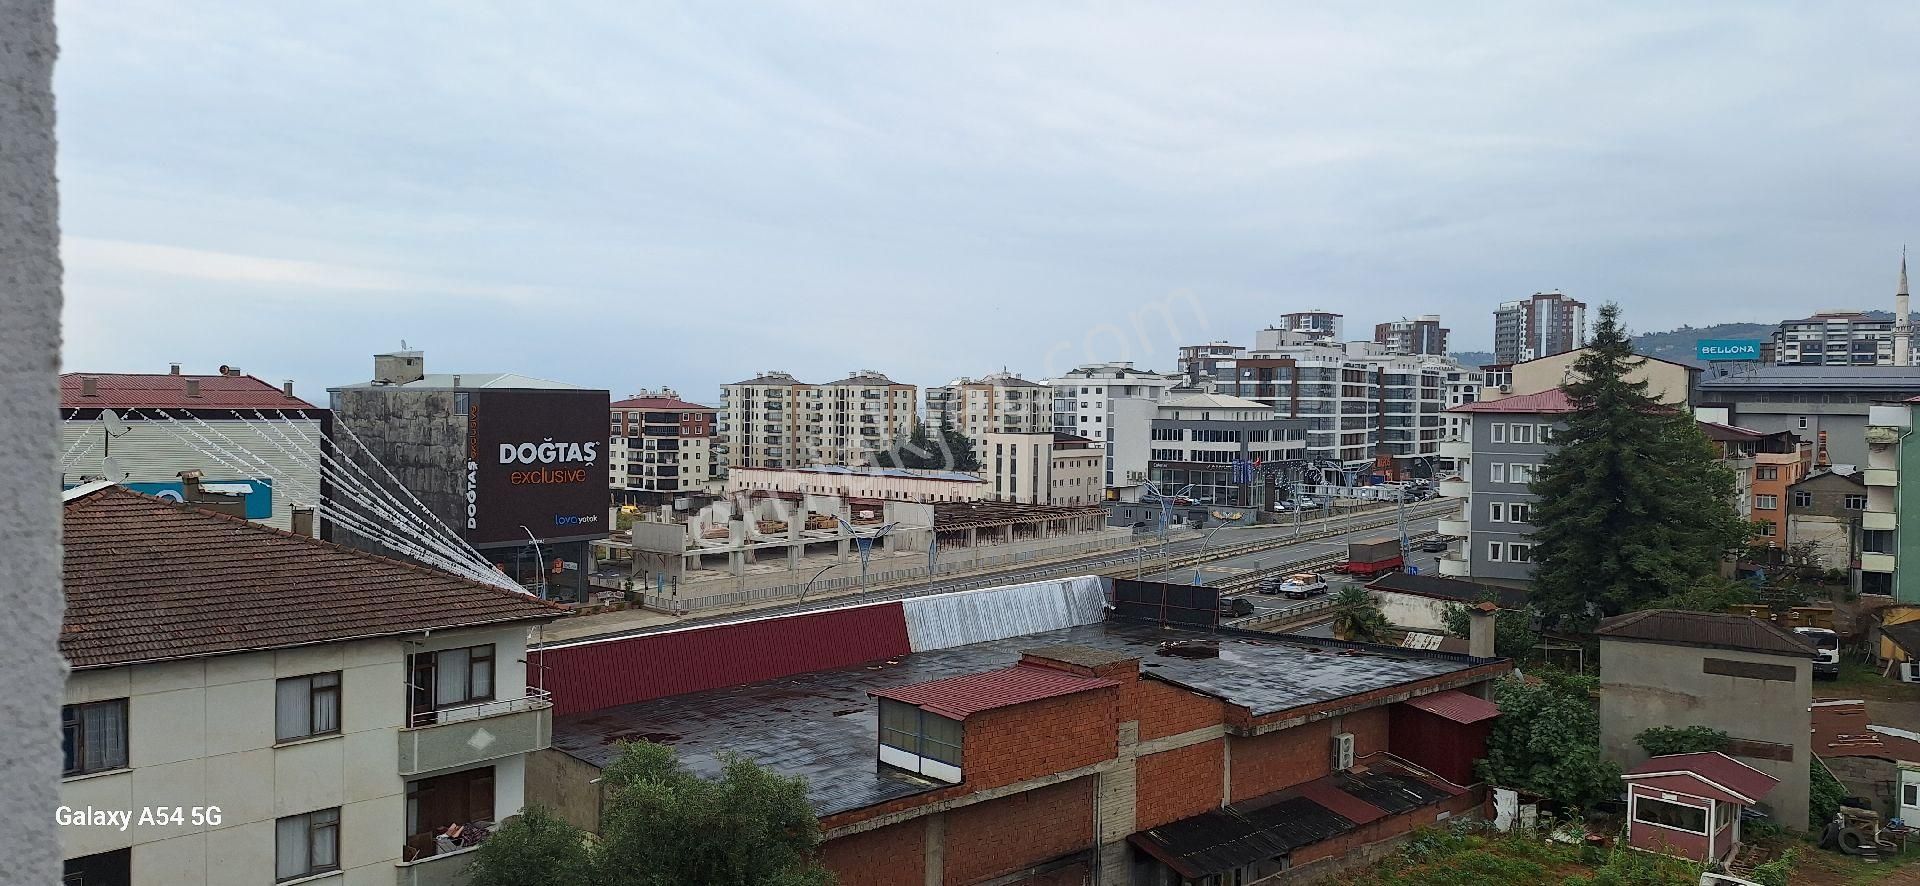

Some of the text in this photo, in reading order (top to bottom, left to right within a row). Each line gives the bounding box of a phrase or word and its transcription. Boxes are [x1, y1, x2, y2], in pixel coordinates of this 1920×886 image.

[1702, 345, 1754, 354] BELLONA
[500, 437, 597, 466] DOĞTAŞ
[511, 467, 586, 484] exclusive
[578, 514, 598, 524] yatak
